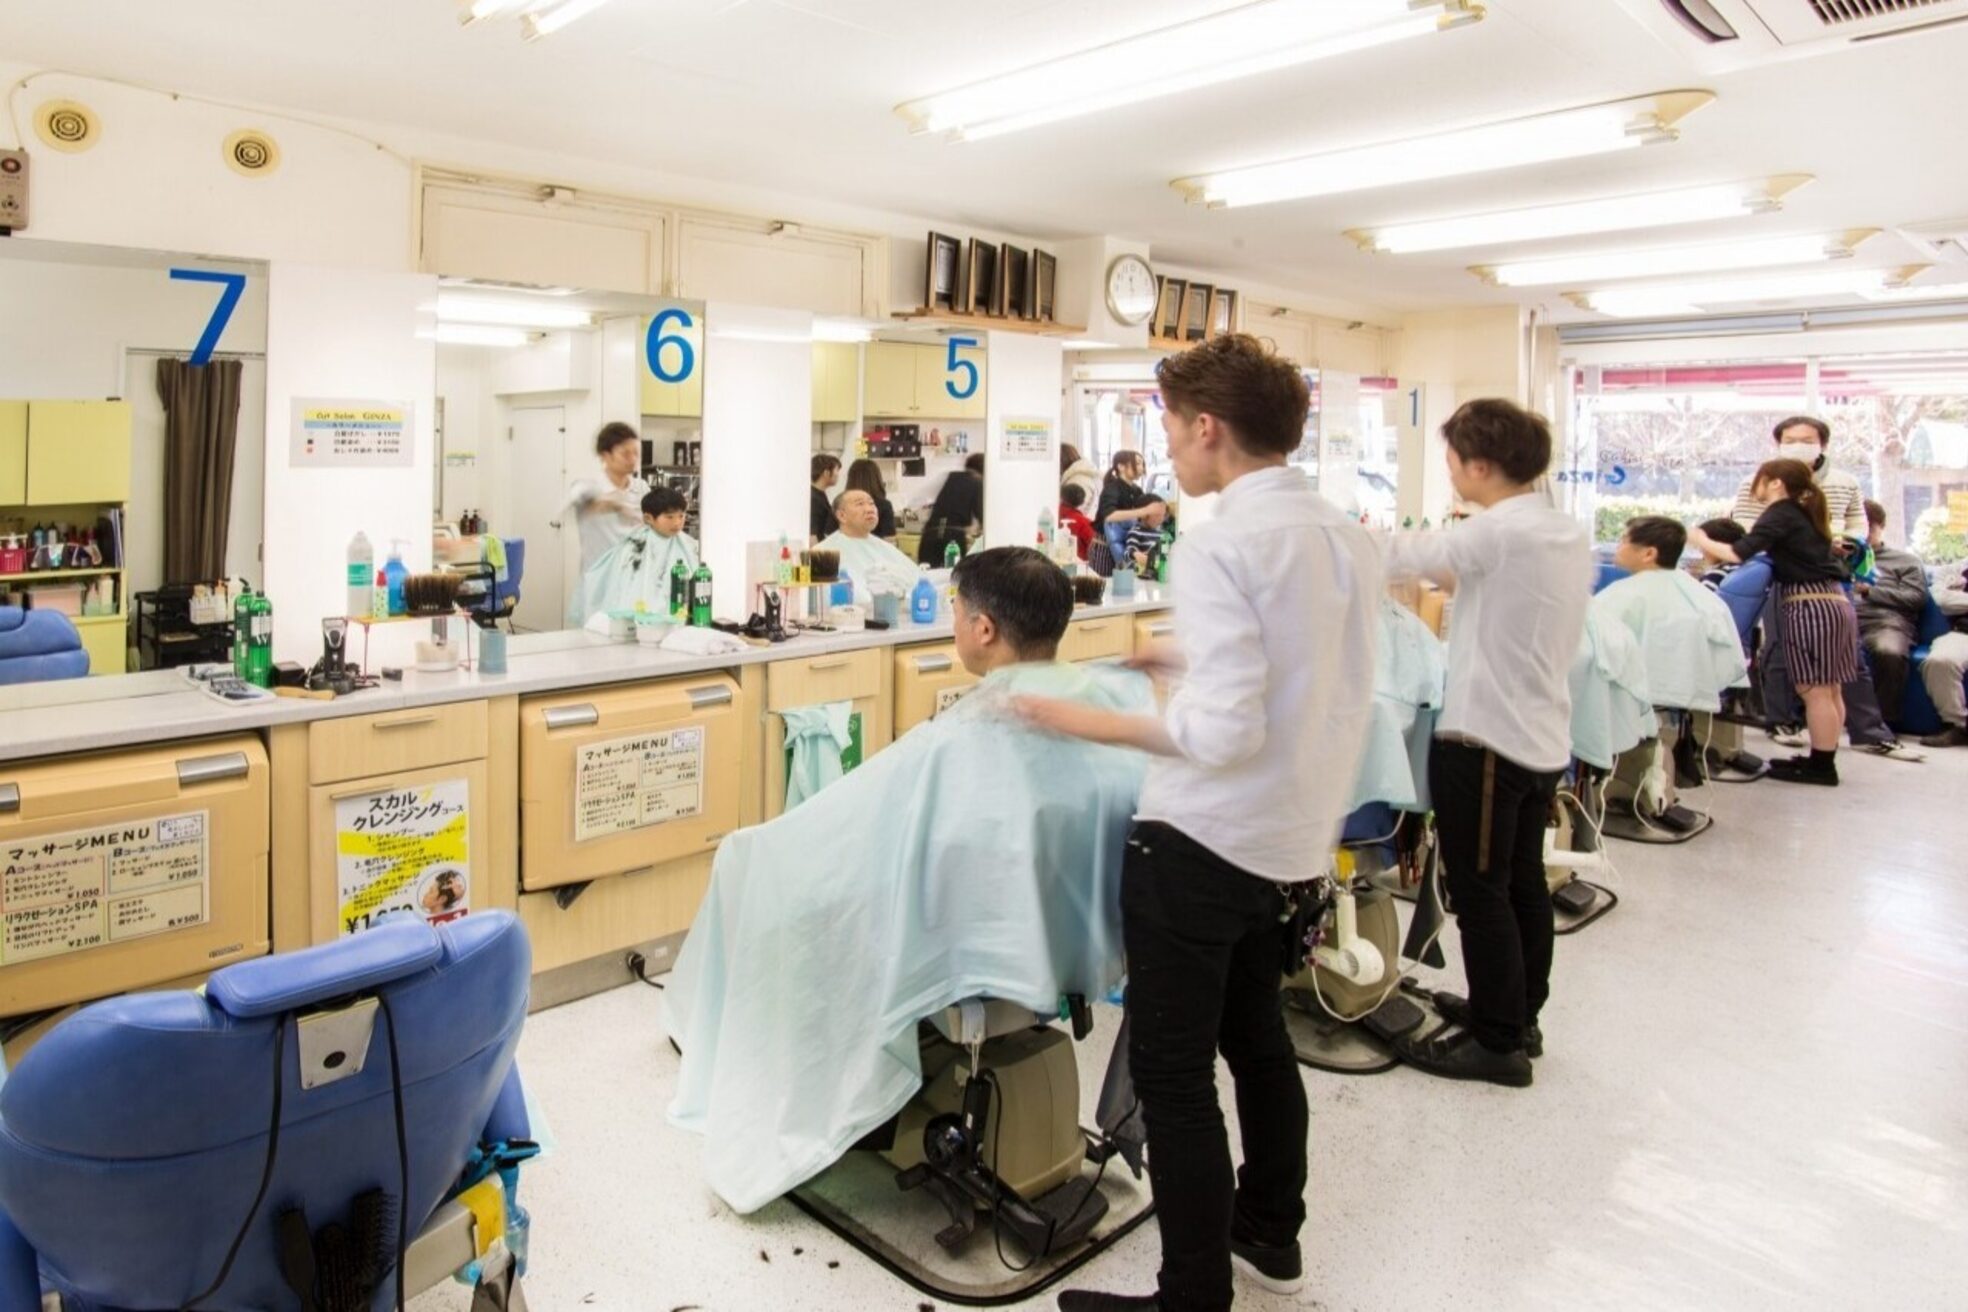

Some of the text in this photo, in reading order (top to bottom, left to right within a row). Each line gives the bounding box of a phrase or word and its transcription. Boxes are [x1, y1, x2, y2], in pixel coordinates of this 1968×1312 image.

[169, 267, 247, 367] 7
[645, 308, 695, 383] 6
[945, 337, 979, 399] 5
[362, 411, 392, 421] GINZA
[1409, 387, 1418, 427] 1
